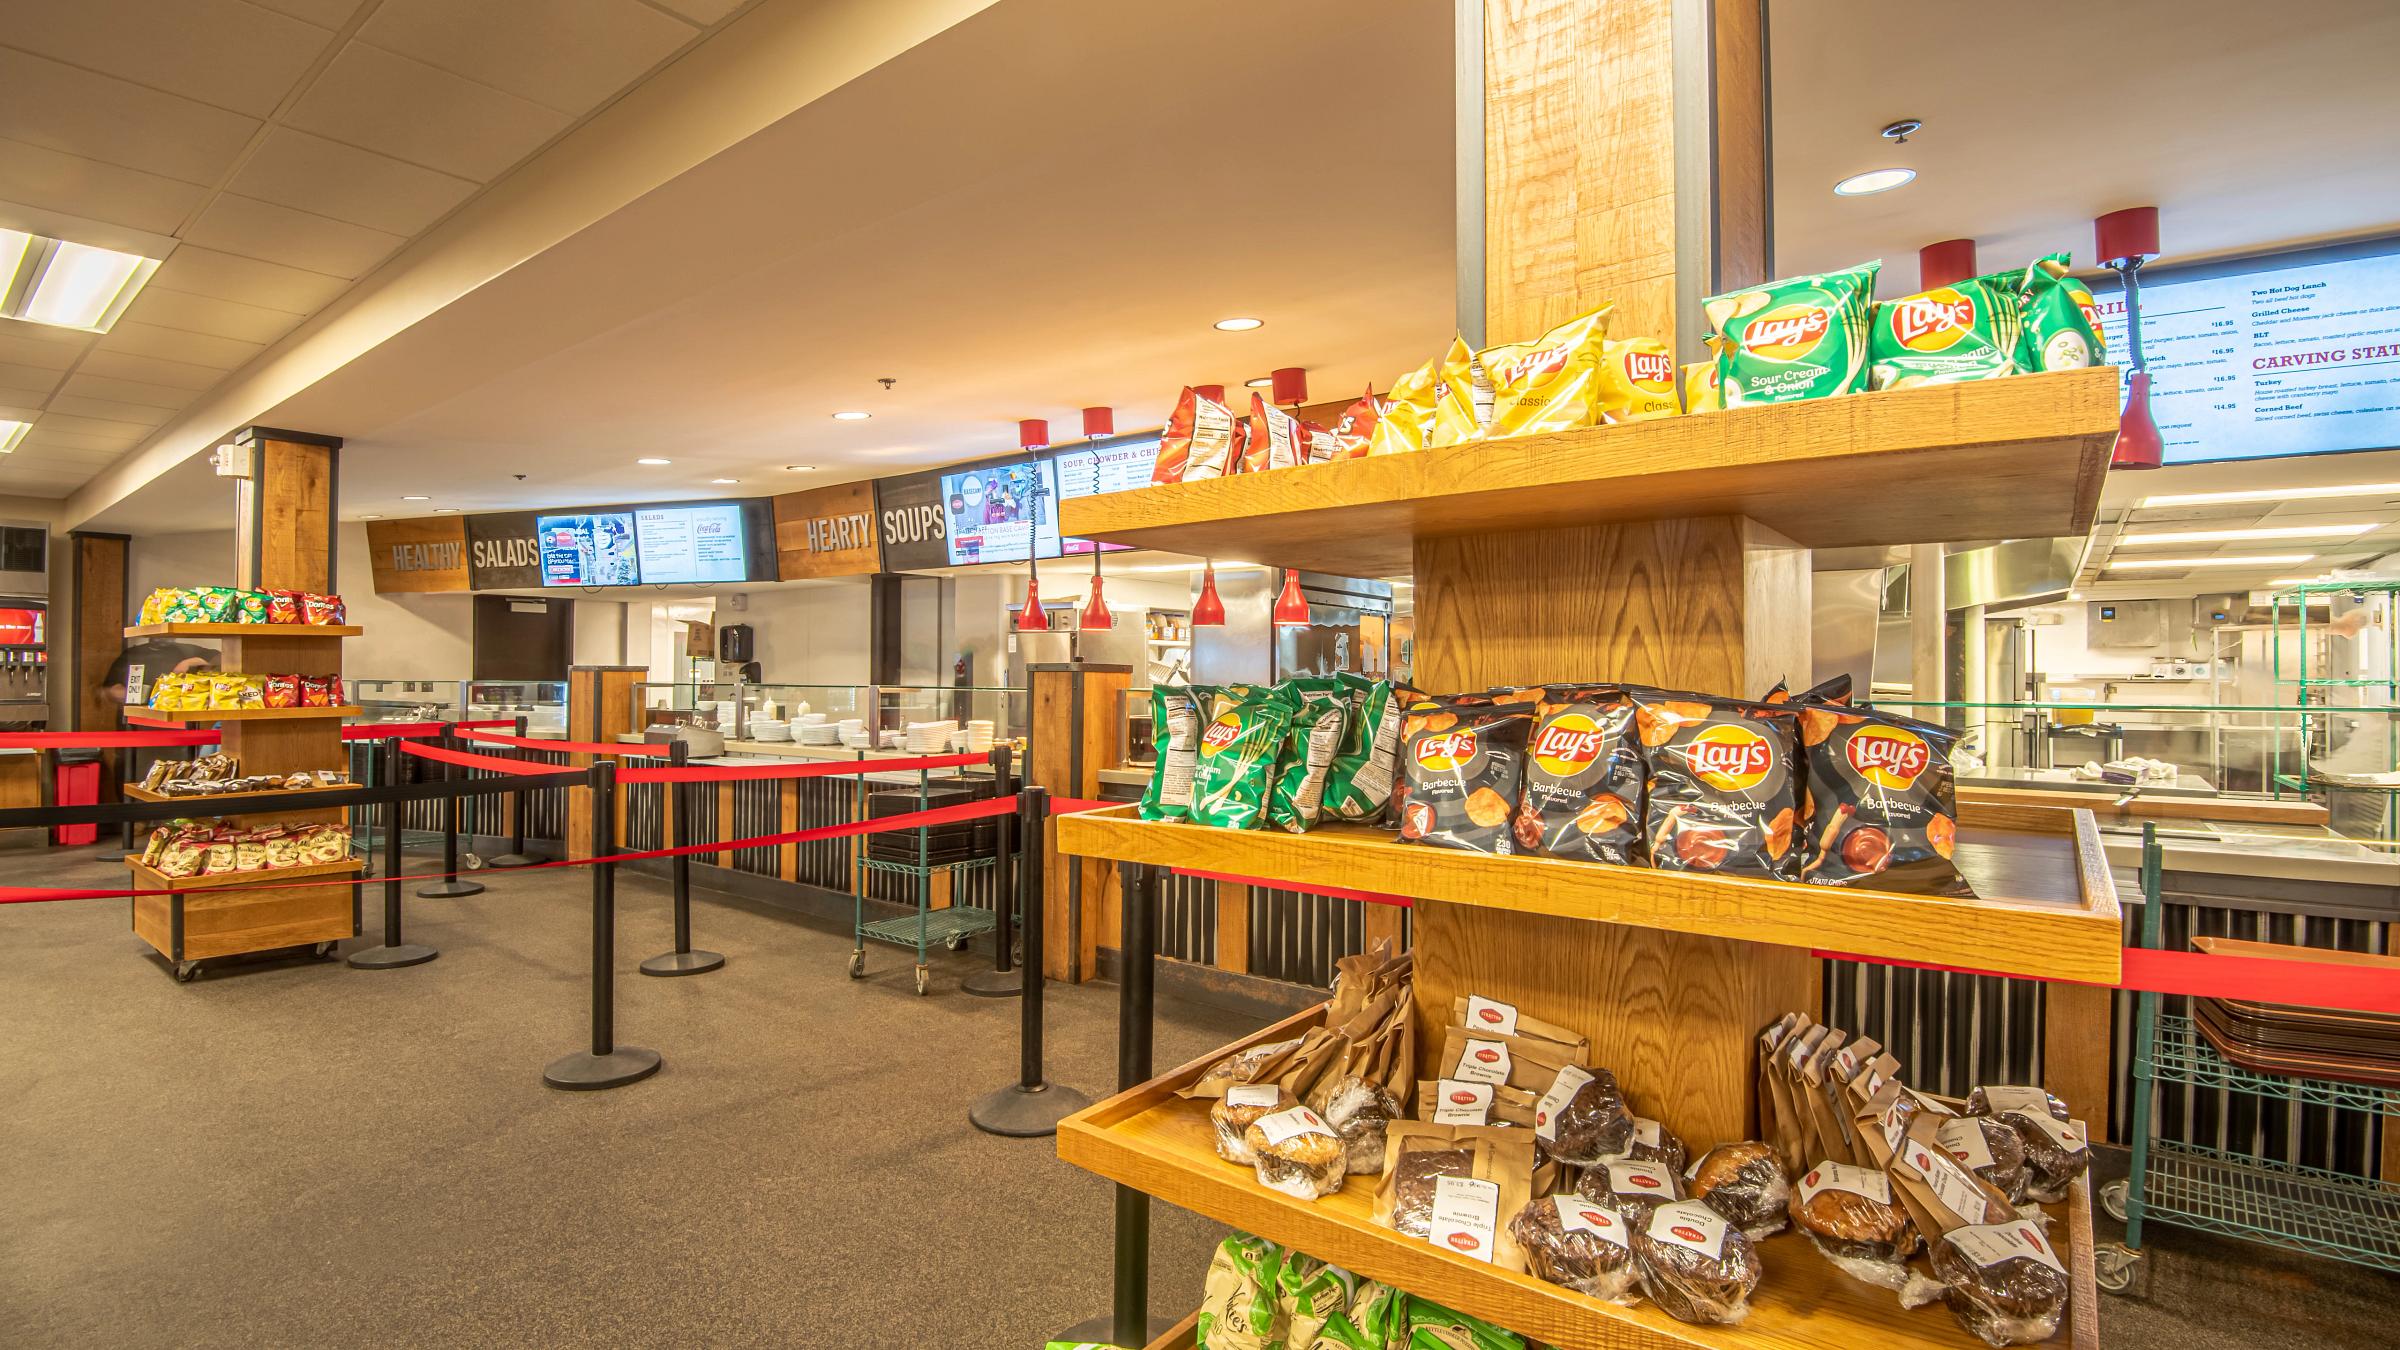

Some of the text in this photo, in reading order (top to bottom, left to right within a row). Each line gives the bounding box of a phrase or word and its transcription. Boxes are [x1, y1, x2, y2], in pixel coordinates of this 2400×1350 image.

[2284, 285, 2300, 293] Dog
[2302, 281, 2327, 290] Lunch
[2251, 306, 2310, 318] Grilled Cheese
[2336, 309, 2358, 317] cheese
[1901, 297, 1968, 342] Lay's
[2212, 319, 2234, 328] $16.95
[1747, 306, 1826, 347] Lay's
[2253, 331, 2270, 339] BLT
[2322, 332, 2346, 341] roasted
[2347, 330, 2366, 339] garlic
[2212, 347, 2235, 355] $16.95
[2252, 349, 2347, 370] CARVING
[1630, 353, 1672, 382] Lay's
[1751, 367, 1828, 388] Sour Cream
[2213, 374, 2236, 383] $16.95
[2254, 379, 2282, 388] Turkey
[1764, 379, 1815, 396] & Onion
[2213, 403, 2236, 411] $14.95
[2254, 403, 2303, 413] Corned Beef
[1087, 452, 1129, 465] CHOWDER
[807, 513, 872, 553] HEARTY
[884, 504, 946, 545] SOUPS
[392, 542, 461, 572] HEALTHY
[474, 538, 540, 569] SALADS
[130, 676, 141, 684] EXIT
[128, 686, 140, 694] ONLY
[1203, 722, 1238, 747] Lay's
[1419, 731, 1474, 758] Lay's
[1536, 726, 1600, 762] Lay's
[1694, 740, 1767, 778] Lay's
[1857, 735, 1928, 777] Lay's
[1422, 777, 1467, 791] Barbecue
[1532, 781, 1582, 799] Barbecue
[1431, 787, 1454, 795] Flavored
[1541, 794, 1568, 804] Flavored
[1710, 799, 1766, 812] Barbecue
[1867, 798, 1922, 814] Barbecue
[1496, 838, 1511, 849] 230
[1480, 1010, 1502, 1021] STRATTON
[1476, 1051, 1499, 1061] STRATTON
[1462, 1062, 1505, 1076] Triple Chocolate
[1470, 1070, 1492, 1079] Brownie
[1631, 1176, 1659, 1187] STRATTON
[1437, 1215, 1472, 1228] Chocolate
[1452, 1210, 1480, 1221] Brownie
[1582, 1211, 1610, 1226] STRATTON
[1676, 1209, 1713, 1223] Chocolate
[1679, 1215, 1705, 1227] Double
[1469, 1220, 1493, 1233] Triple
[1672, 1227, 1704, 1241] STRATTON
[1449, 1235, 1478, 1248] STRATTON
